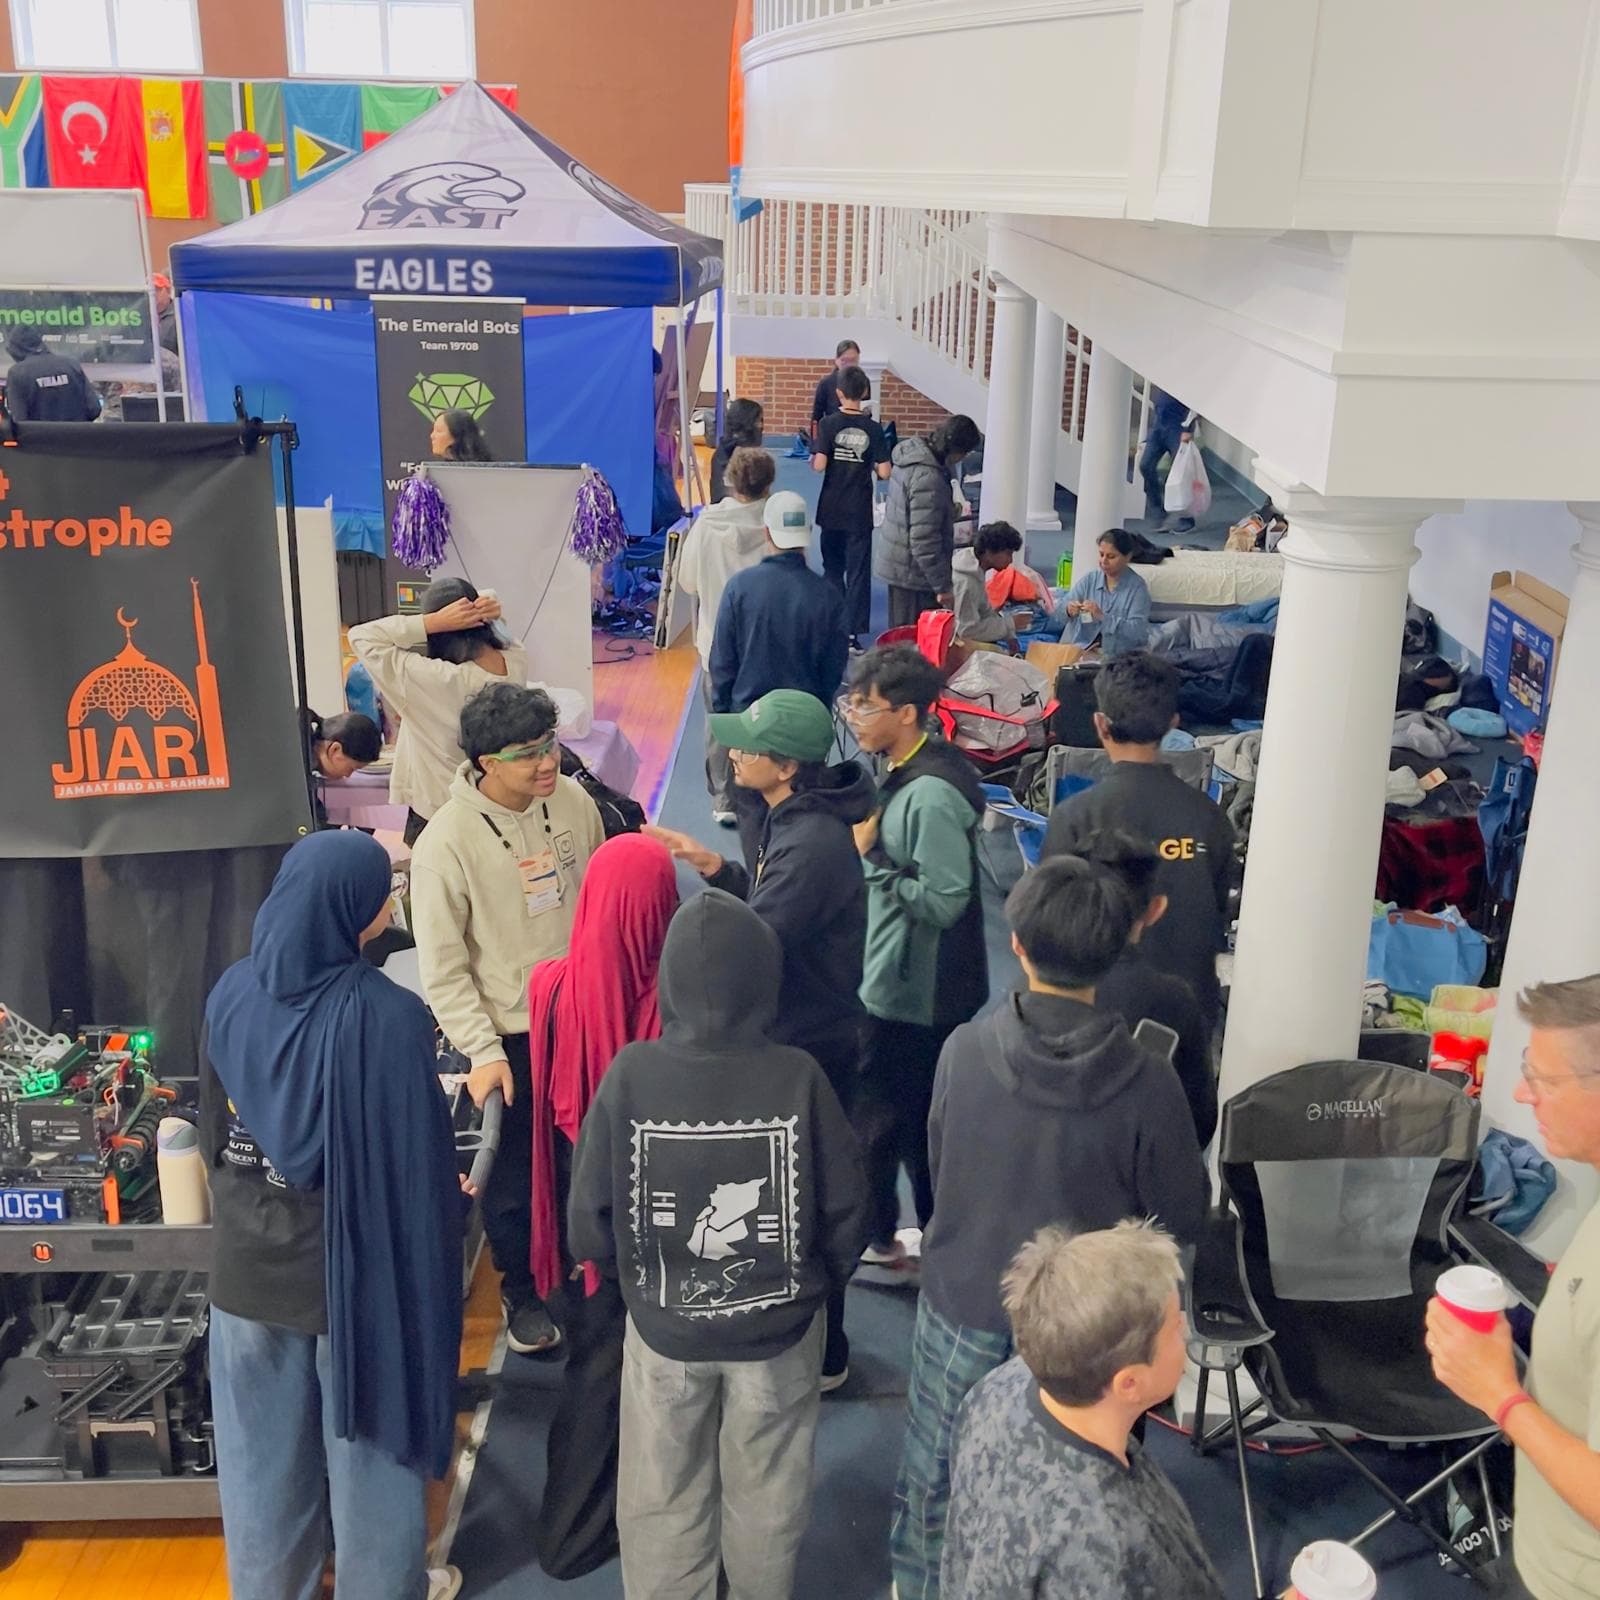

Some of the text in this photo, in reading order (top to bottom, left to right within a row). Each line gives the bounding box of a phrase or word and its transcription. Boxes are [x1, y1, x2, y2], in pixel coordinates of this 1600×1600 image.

[357, 207, 518, 230] EAST
[355, 258, 494, 293] EAGLES
[89, 306, 142, 327] Bots
[378, 318, 520, 334] The Emerald Bots
[420, 341, 448, 351] Team
[52, 726, 198, 784] JIAR
[59, 776, 225, 797] JAMAAT IBAD AR-RAHMAN
[1324, 1100, 1382, 1115] MAGELLAN
